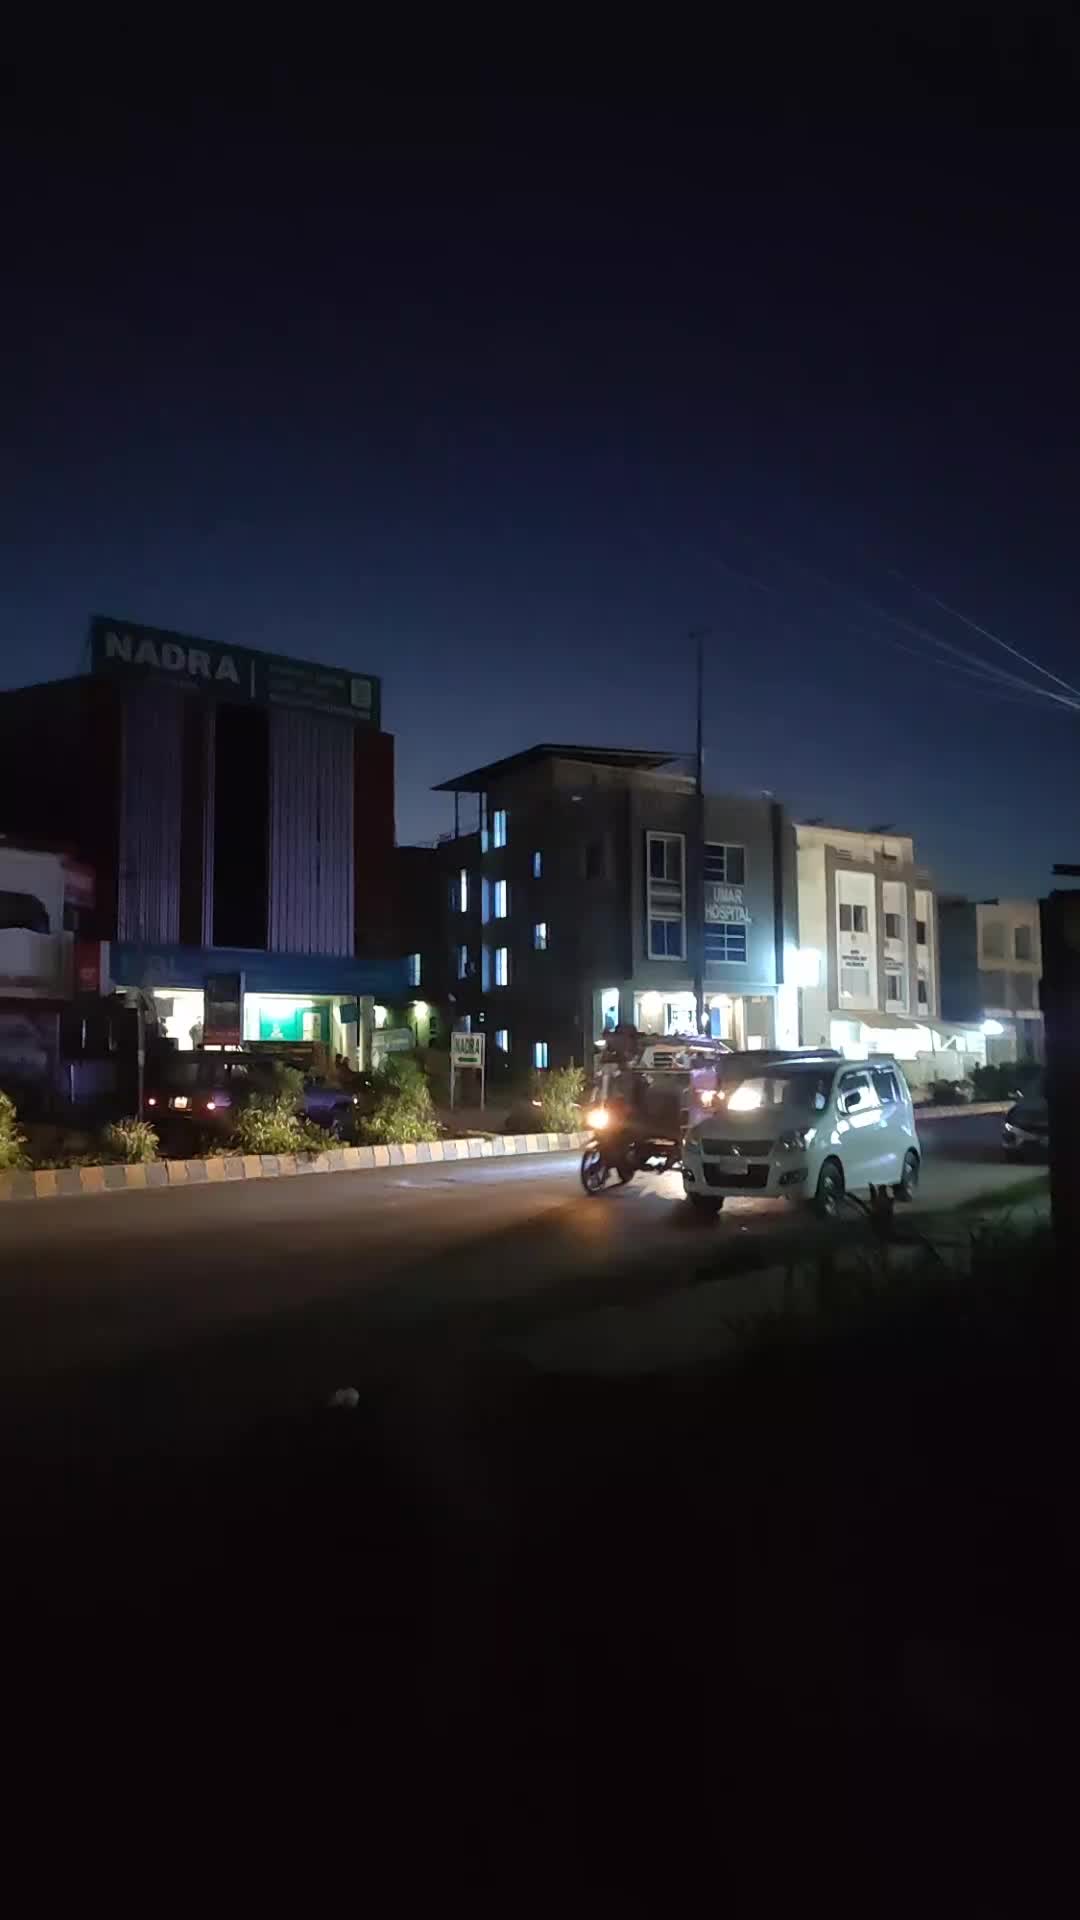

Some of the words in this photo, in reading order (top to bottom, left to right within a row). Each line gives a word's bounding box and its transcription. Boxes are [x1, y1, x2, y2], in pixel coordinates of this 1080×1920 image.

[105, 631, 240, 684] NADRA
[713, 887, 744, 904] UMAR
[704, 904, 752, 923] HOSPITAL
